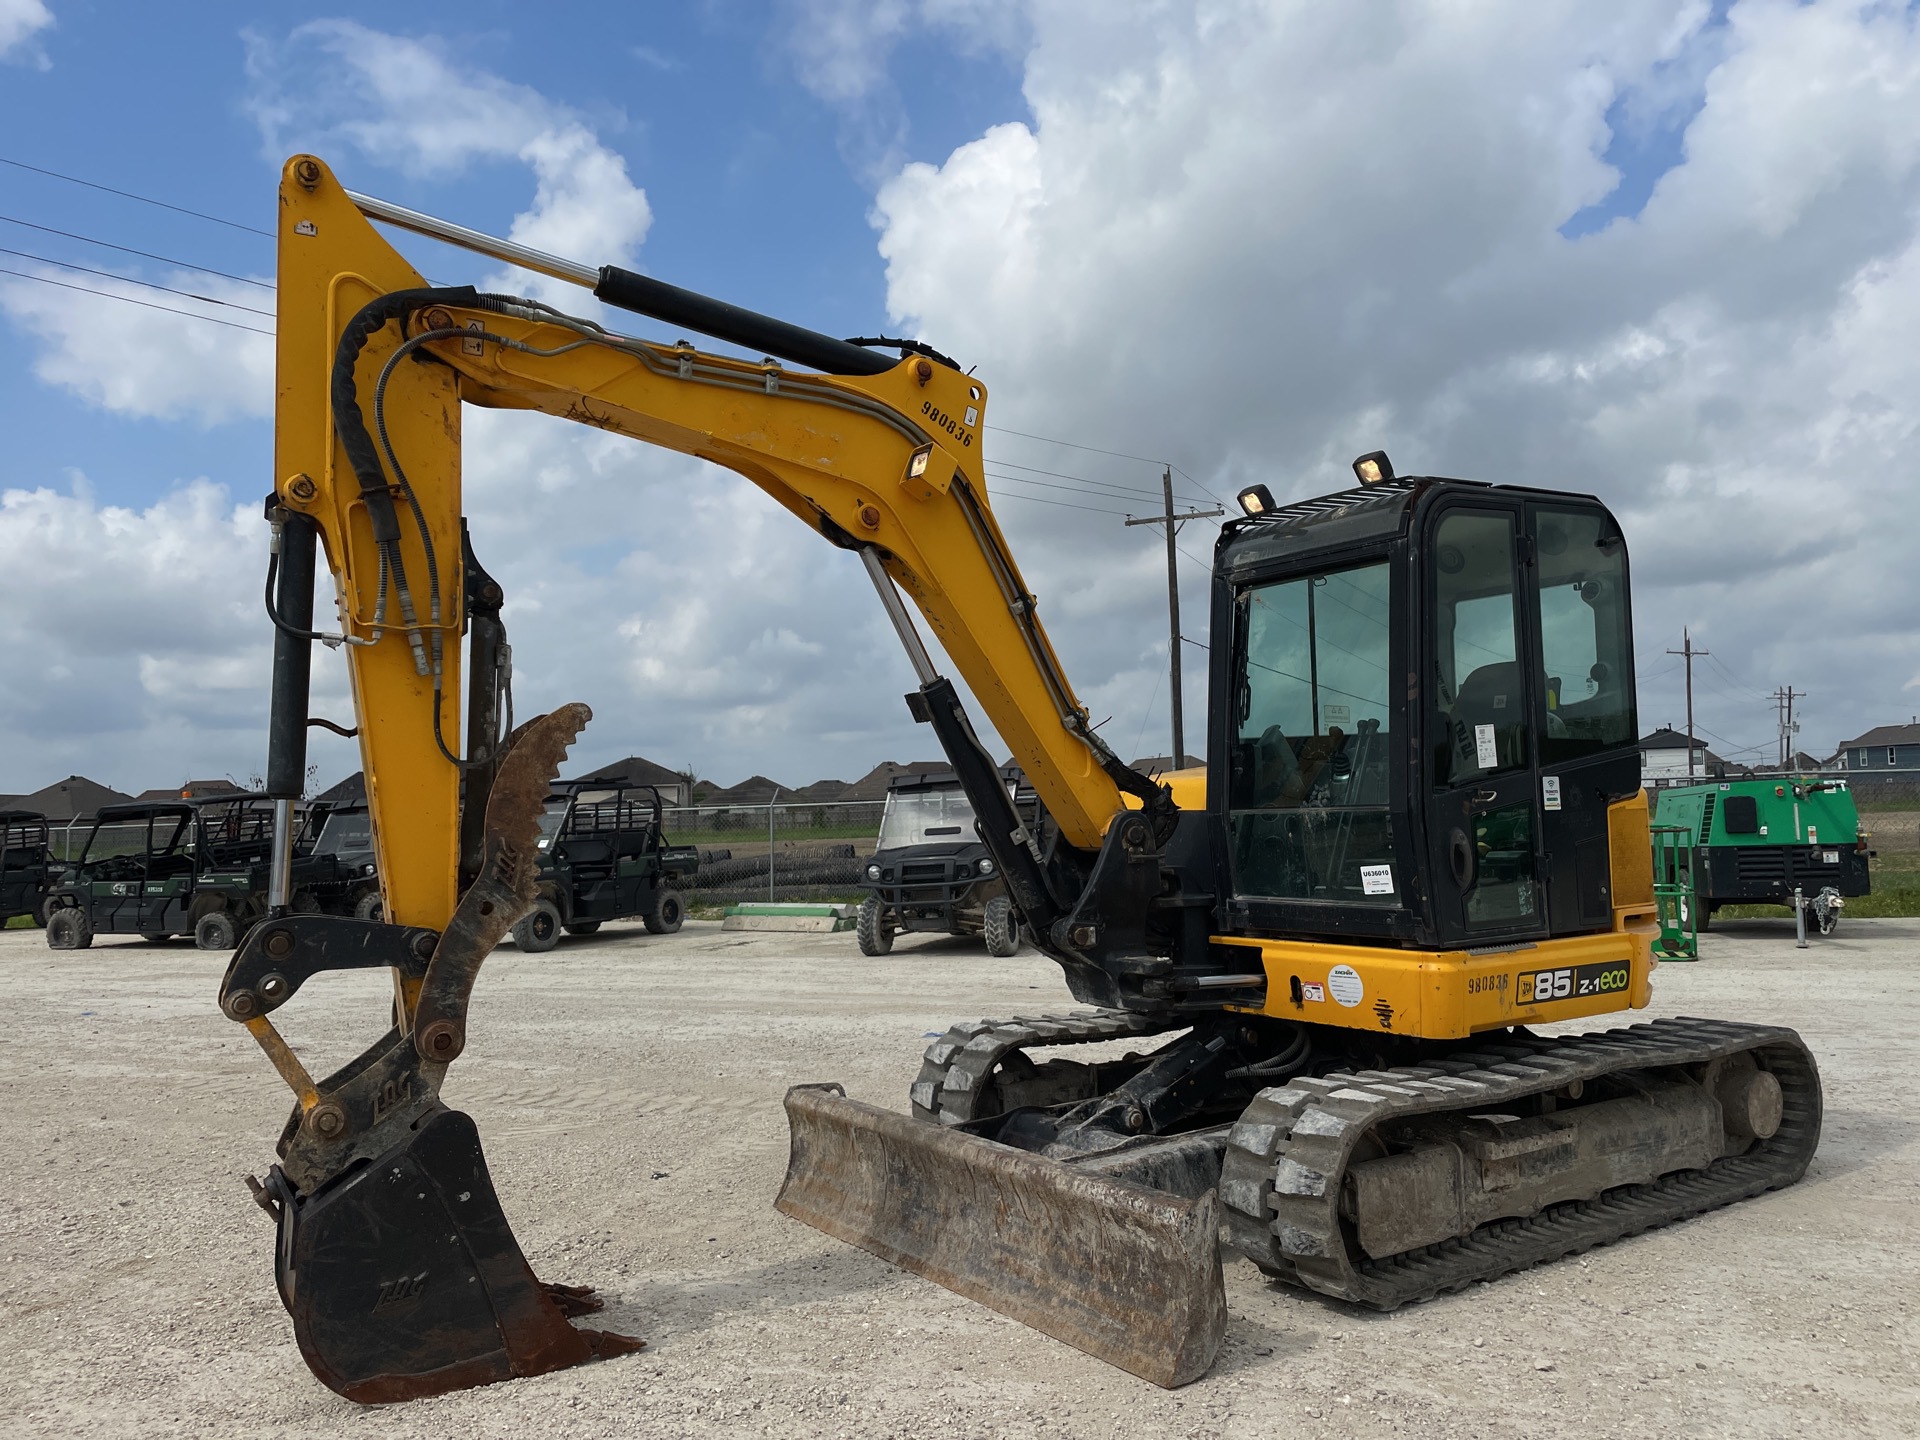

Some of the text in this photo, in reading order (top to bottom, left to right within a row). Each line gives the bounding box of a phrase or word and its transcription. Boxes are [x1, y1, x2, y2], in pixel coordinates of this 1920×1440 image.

[921, 401, 973, 447] 980836
[1468, 973, 1508, 994] 980836
[1521, 980, 1532, 998] JCB
[1534, 969, 1571, 1000] 85
